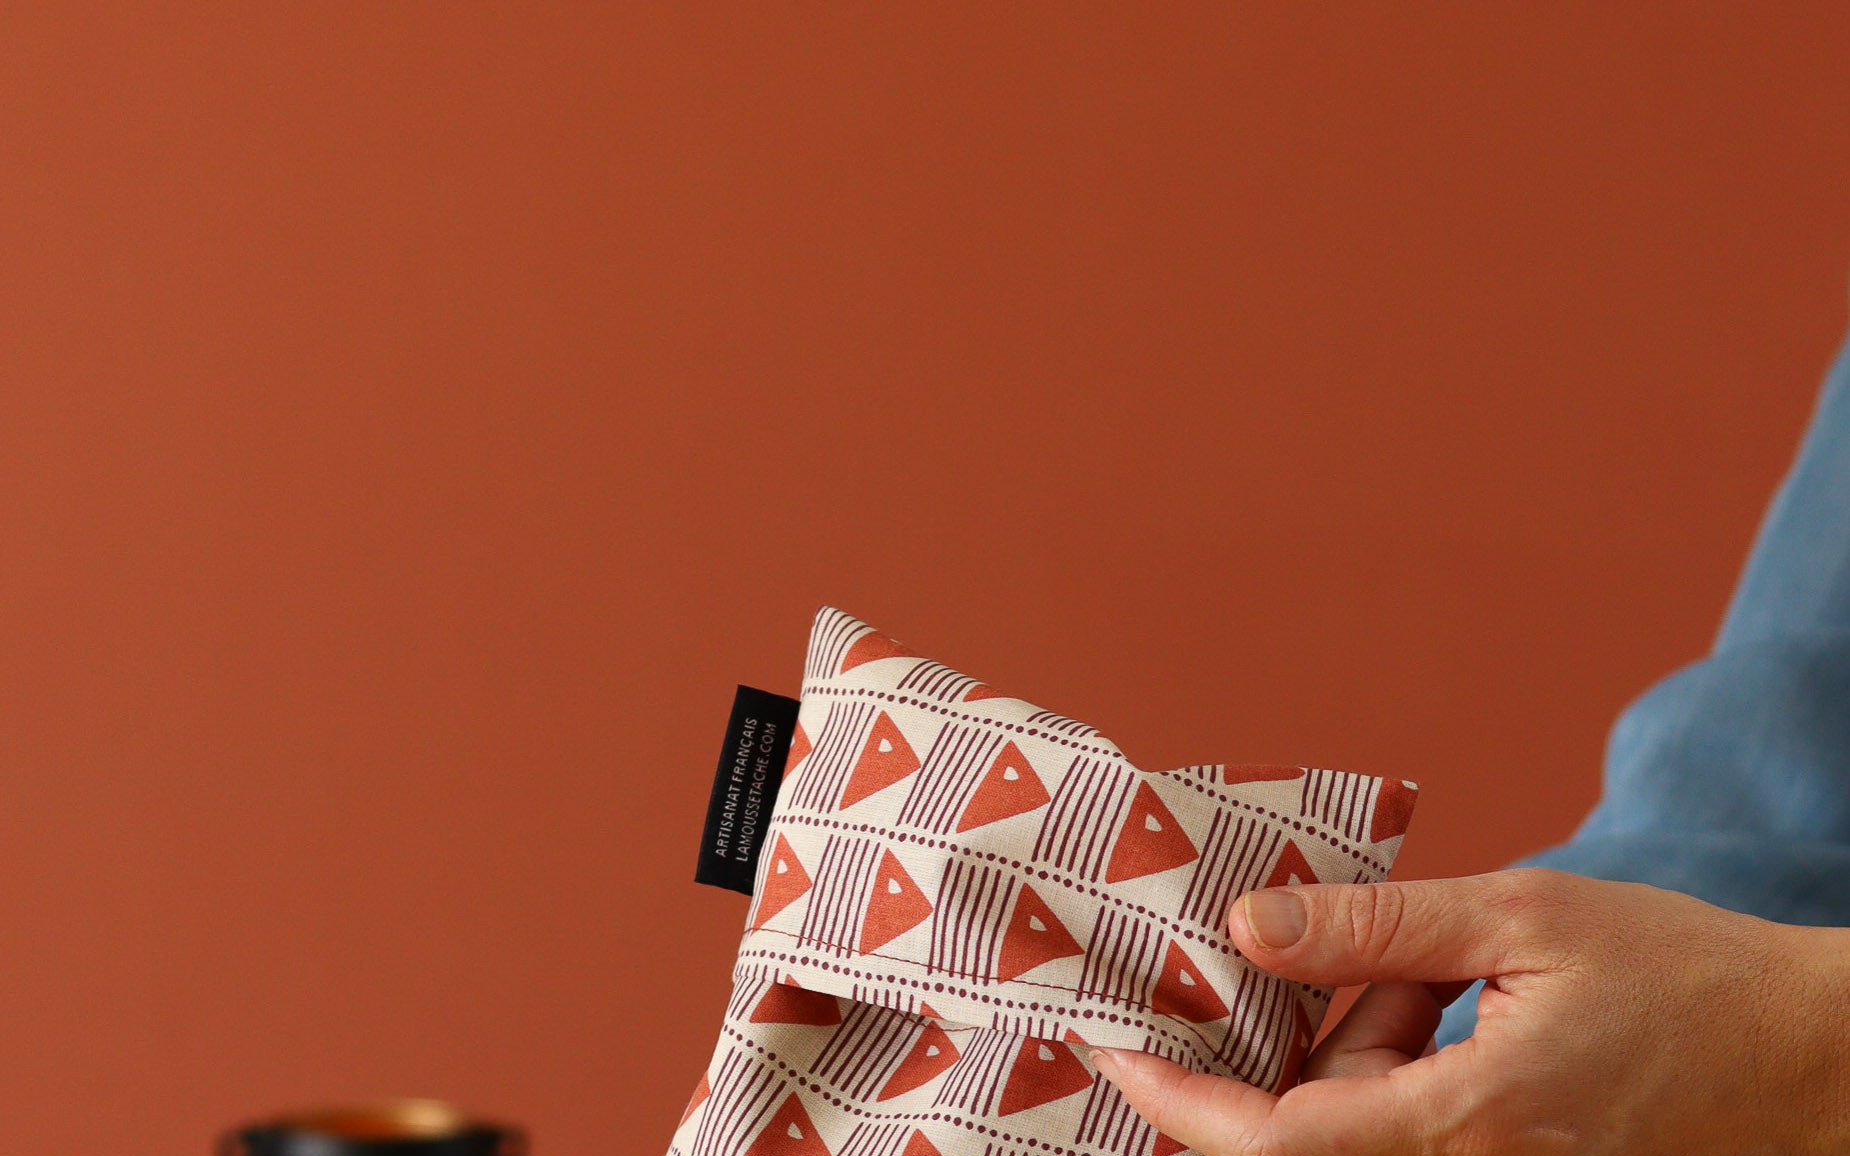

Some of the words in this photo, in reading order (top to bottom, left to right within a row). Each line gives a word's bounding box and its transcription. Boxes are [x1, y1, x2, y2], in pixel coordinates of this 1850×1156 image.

[715, 784, 740, 858] ARTISANAT
[732, 717, 758, 784] FRANÇAIS
[736, 722, 777, 862] LAMOUSSETACHE.COM
